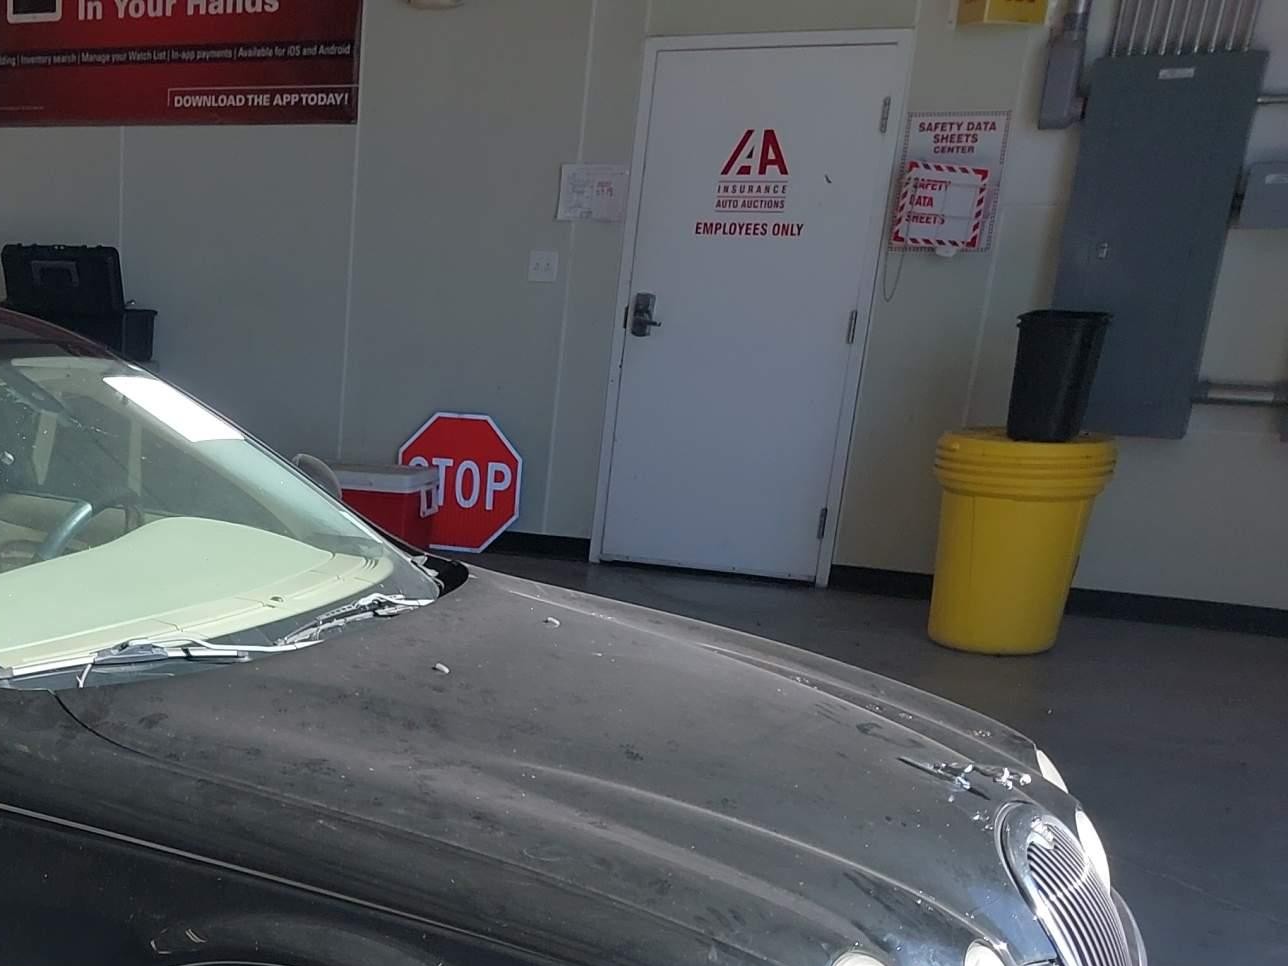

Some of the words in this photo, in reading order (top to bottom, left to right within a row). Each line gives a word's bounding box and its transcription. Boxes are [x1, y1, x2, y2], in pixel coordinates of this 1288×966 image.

[78, 0, 103, 21] In
[113, 0, 177, 19] Your
[81, 52, 110, 64] Manage
[238, 46, 273, 58] Available
[274, 46, 285, 57] for
[302, 44, 317, 56] and
[318, 43, 351, 56] Android
[174, 94, 246, 108] DOWNLOAD
[246, 94, 271, 107] THE
[272, 93, 300, 106] APP
[300, 92, 349, 106] TODAY!
[918, 121, 963, 132] SAFETY
[966, 120, 997, 131] DATA
[933, 132, 979, 145] SHEETS
[933, 145, 975, 154] CENTER
[717, 184, 788, 194] INSURANCE
[715, 199, 739, 209] AUTO
[740, 199, 786, 209] AUCTIONS
[695, 221, 768, 236] EMPLOYEES
[771, 222, 805, 237] ONLY
[408, 456, 512, 511] TOP
